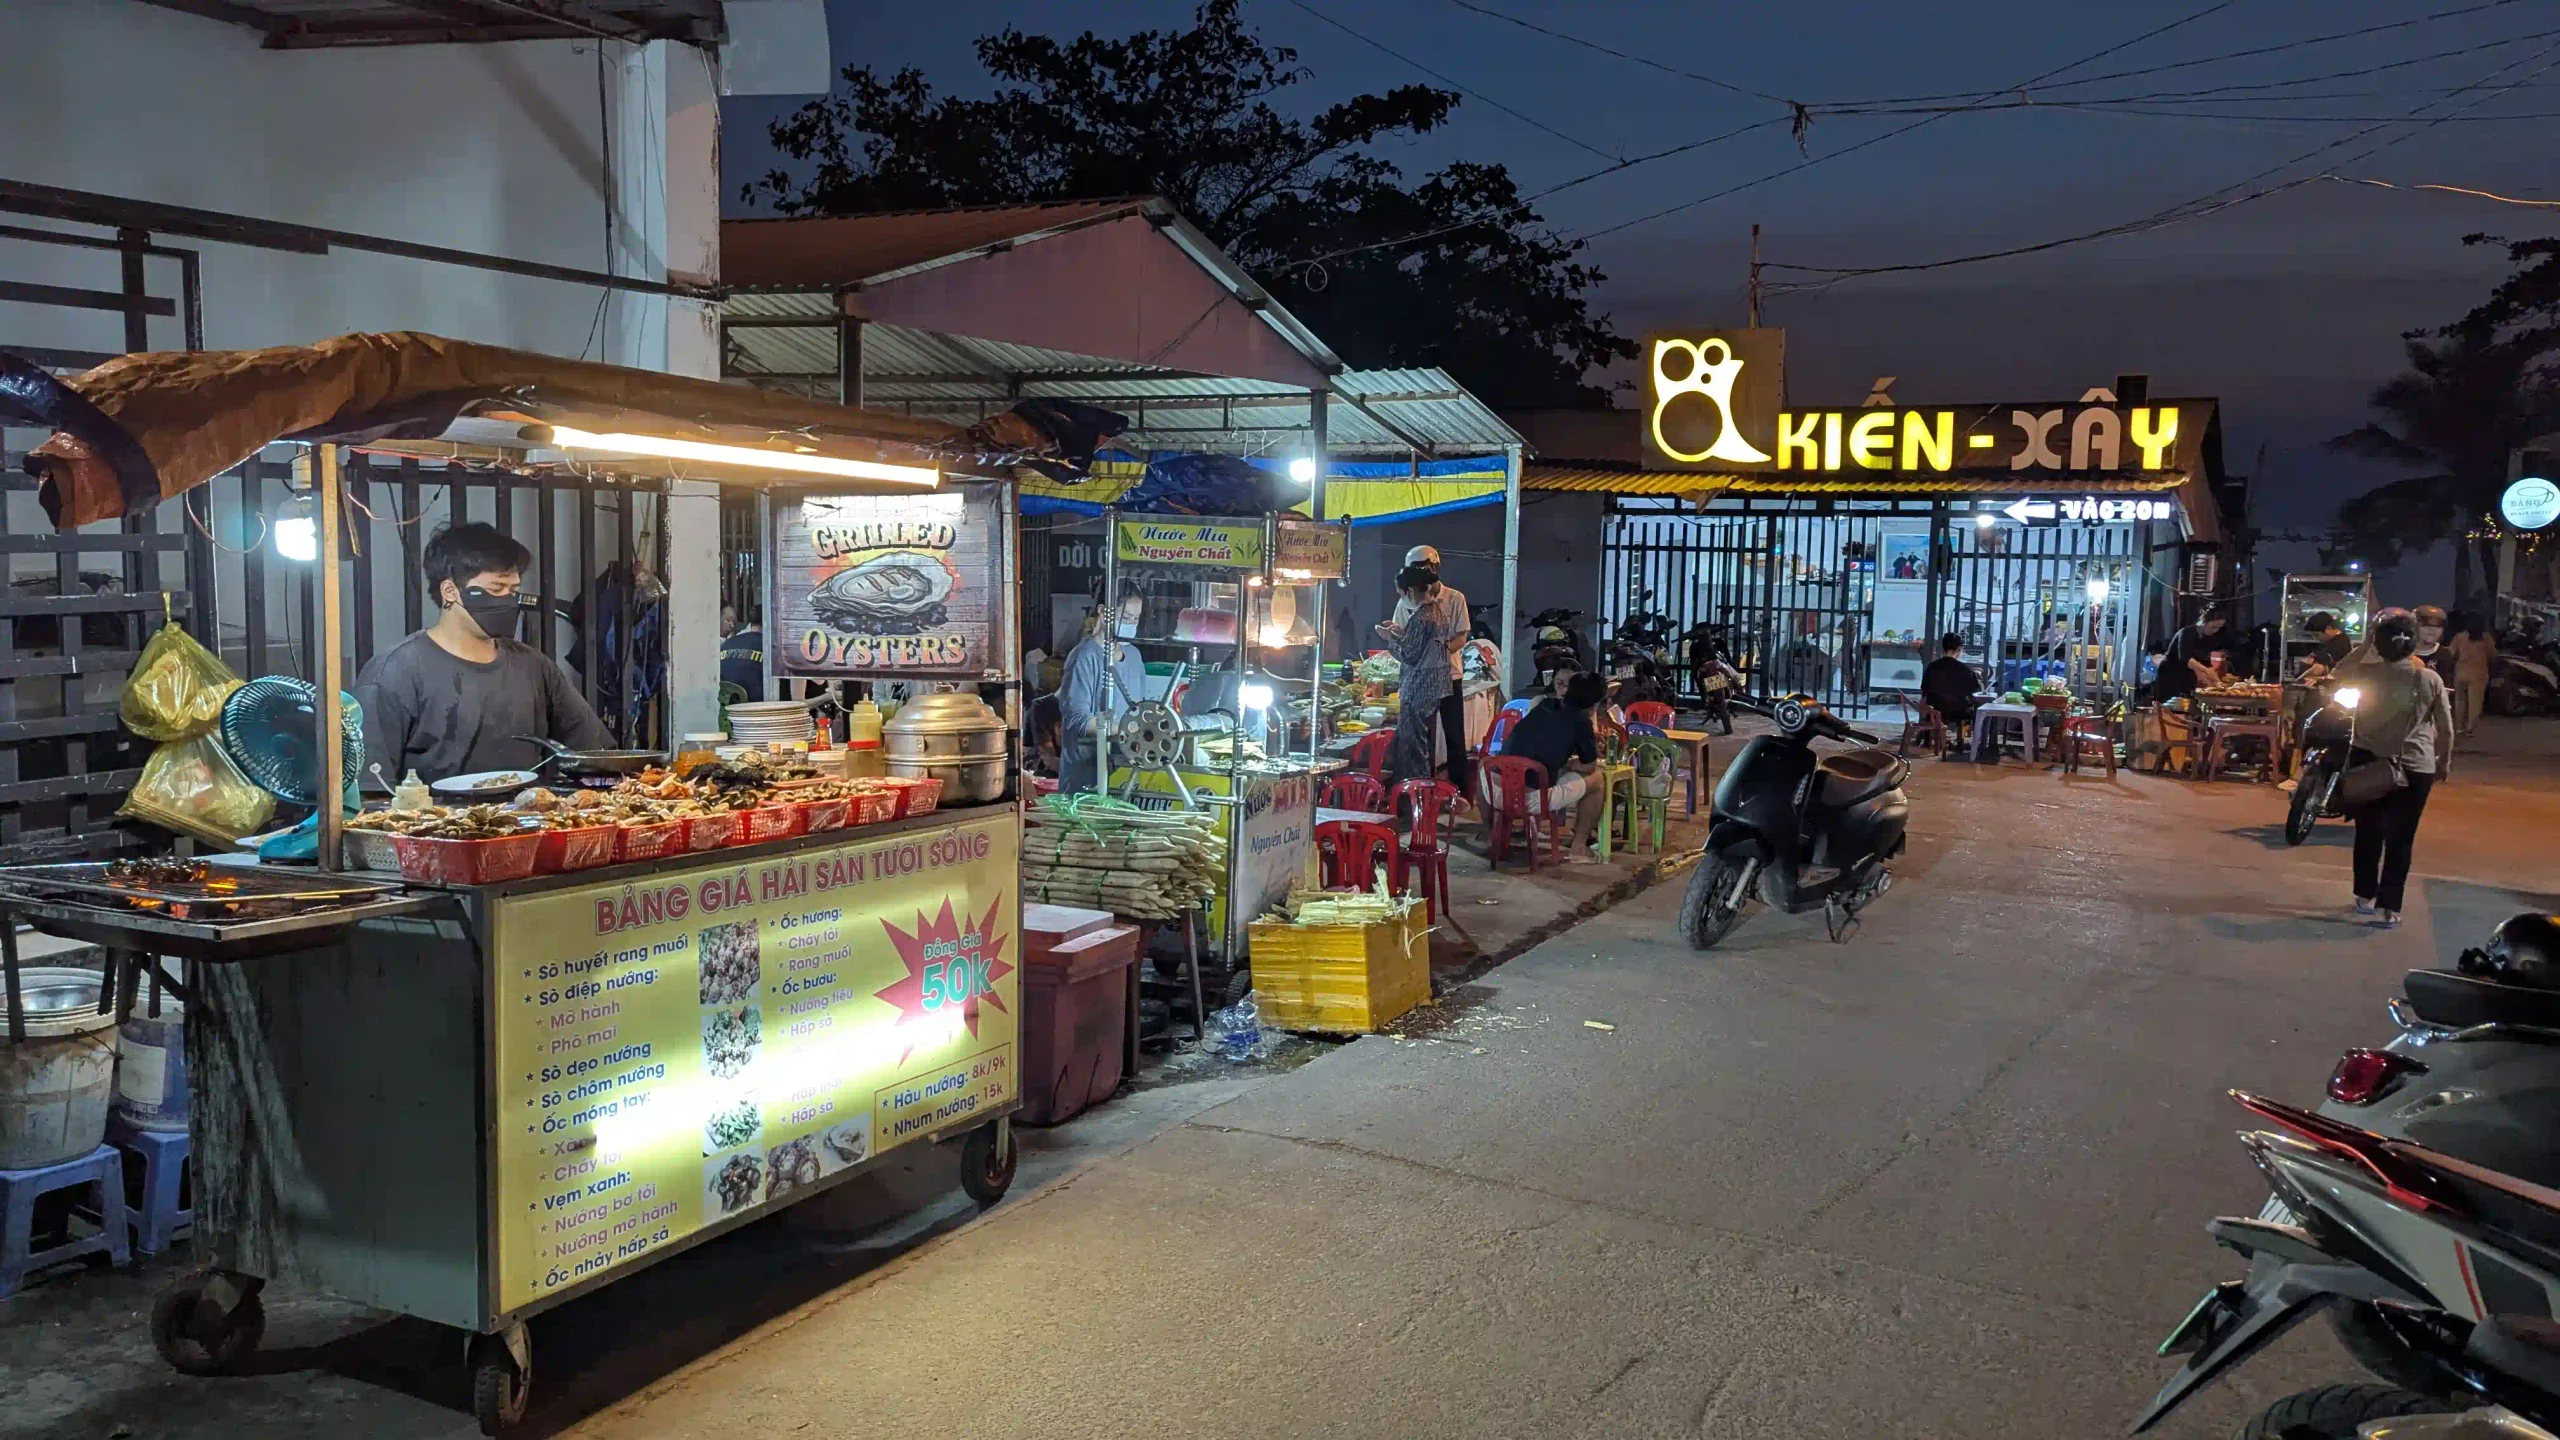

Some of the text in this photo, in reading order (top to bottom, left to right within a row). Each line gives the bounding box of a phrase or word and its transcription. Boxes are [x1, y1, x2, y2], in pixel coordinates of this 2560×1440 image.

[1776, 375, 1955, 472] KIẾN
[2010, 386, 2179, 472] XÂY
[2065, 496, 2115, 520] VÀO
[811, 521, 957, 560] GRILLED
[1138, 526, 1187, 540] Nước
[1138, 545, 1232, 560] Nguyên Chất
[801, 628, 968, 667] OYSTERS
[595, 827, 991, 935] BẢNG GIÁ HẢI SẢN TƯƠI SỐNG
[780, 908, 842, 929] Ốc hương:
[538, 933, 689, 980] Sò huyết rang muối
[789, 932, 820, 949] Cháy
[789, 943, 851, 971] Rang muối
[924, 931, 983, 960] Đồng Giá
[539, 968, 659, 1006] Sò điệp nướng:
[782, 972, 837, 995] Ốc bươu:
[921, 951, 994, 1012] 50k
[581, 1001, 621, 1021] hành
[790, 987, 854, 1016] Nướng tiêu
[551, 1025, 618, 1055] Phô mai
[790, 1012, 833, 1036] Hấp sả
[541, 1041, 651, 1083] Sò dẹo nướng
[541, 1062, 665, 1109] Sò chôm nướng
[894, 1055, 1007, 1110] Hàu nướng: 8k/9k
[542, 1091, 651, 1133] Ốc móng tay:
[791, 1098, 834, 1124] Hấp sả
[894, 1083, 1004, 1138] Nhum nướng: 15k
[544, 1171, 632, 1212] Vẹm xanh:
[555, 1183, 657, 1233] Nướng bơ tỏi
[641, 1200, 678, 1225] hành
[545, 1224, 669, 1287] Ốc nhảy hấp sả
